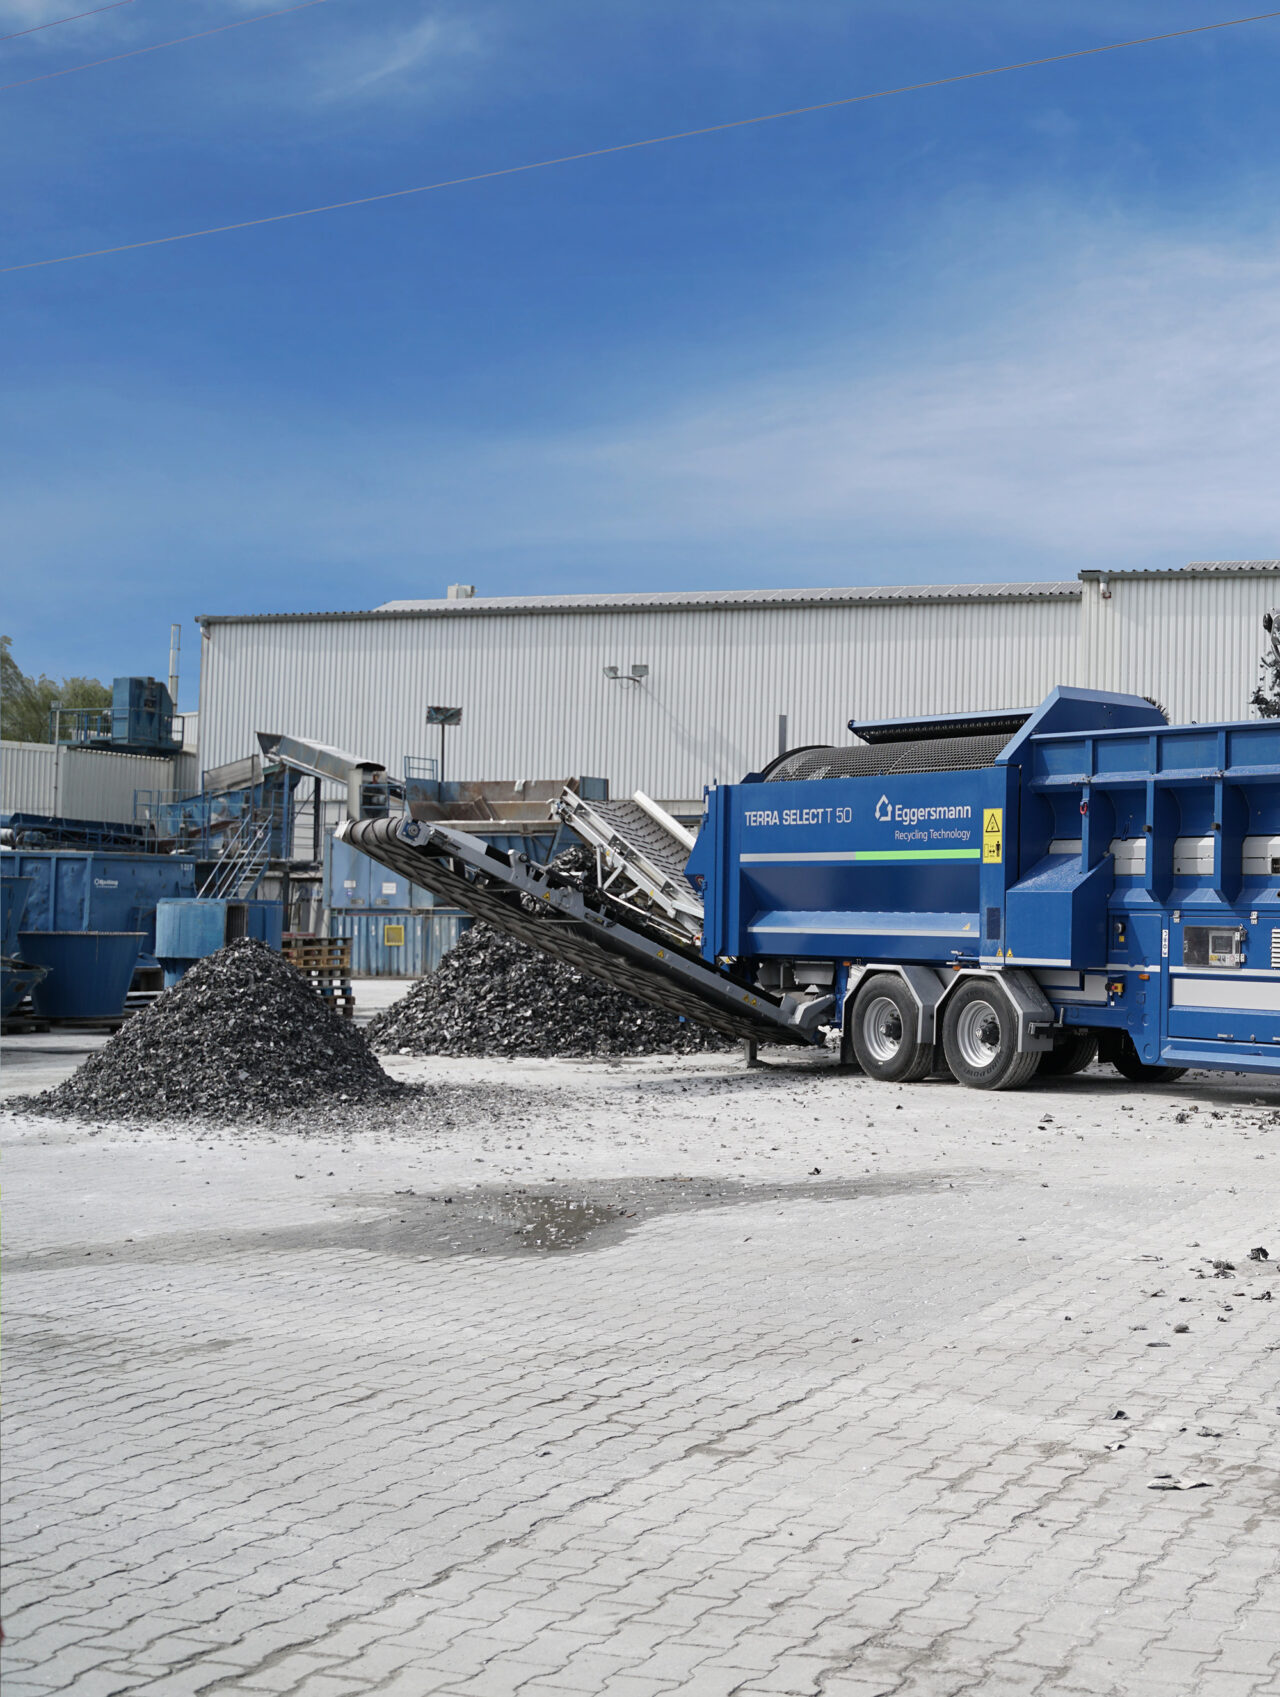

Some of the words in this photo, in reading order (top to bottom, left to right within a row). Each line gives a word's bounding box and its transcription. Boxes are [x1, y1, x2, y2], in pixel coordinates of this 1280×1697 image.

[744, 810, 780, 826] TERRA
[782, 808, 824, 825] SELECT
[825, 808, 833, 824] T
[836, 807, 852, 824] 50
[895, 804, 972, 825] Eggersmann
[894, 830, 928, 842] Recycling
[929, 828, 971, 841] Technology
